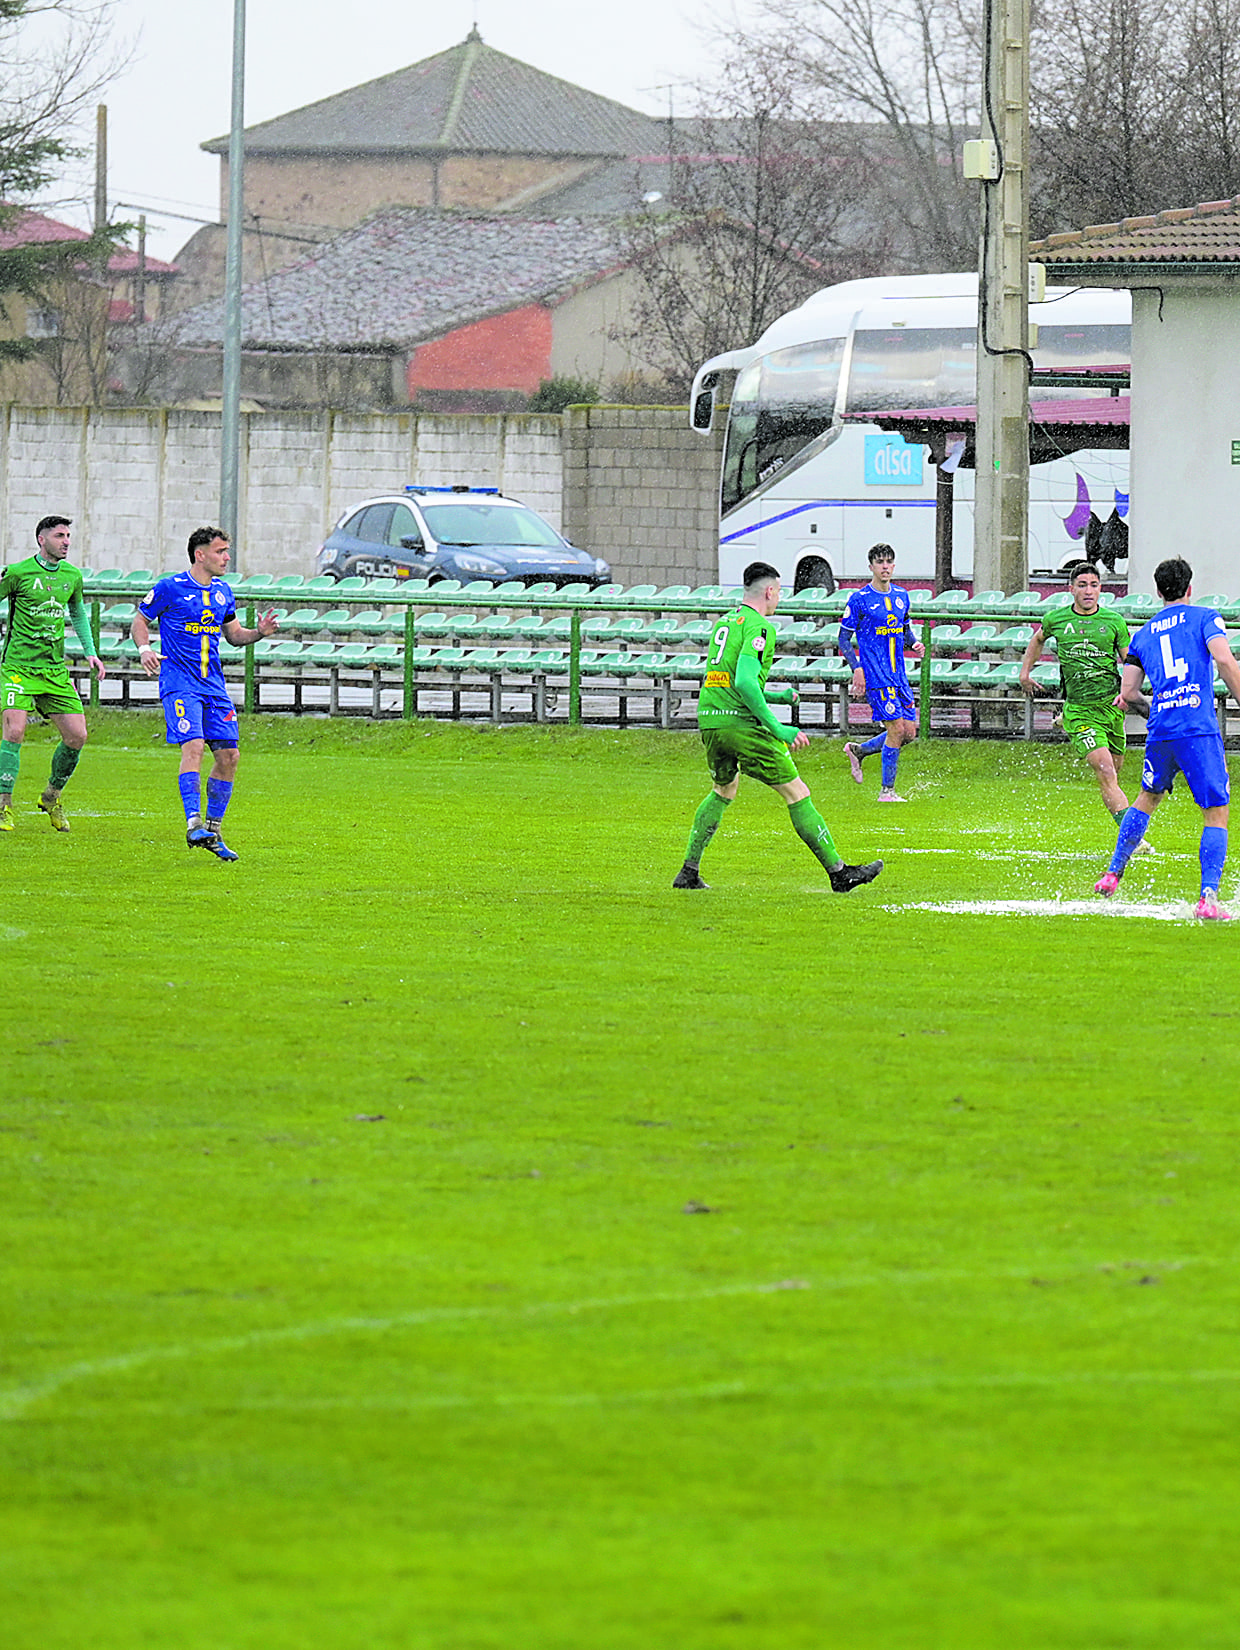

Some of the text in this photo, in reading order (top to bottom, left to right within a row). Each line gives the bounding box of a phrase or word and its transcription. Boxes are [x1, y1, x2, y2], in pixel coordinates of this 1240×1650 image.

[874, 444, 912, 476] alsa
[356, 561, 399, 578] POLICIA
[1150, 615, 1178, 634] PABLO
[710, 626, 730, 665] 9
[1159, 633, 1189, 683] 4
[6, 691, 15, 706] 8
[1162, 682, 1201, 699] euronics
[174, 699, 186, 717] 6
